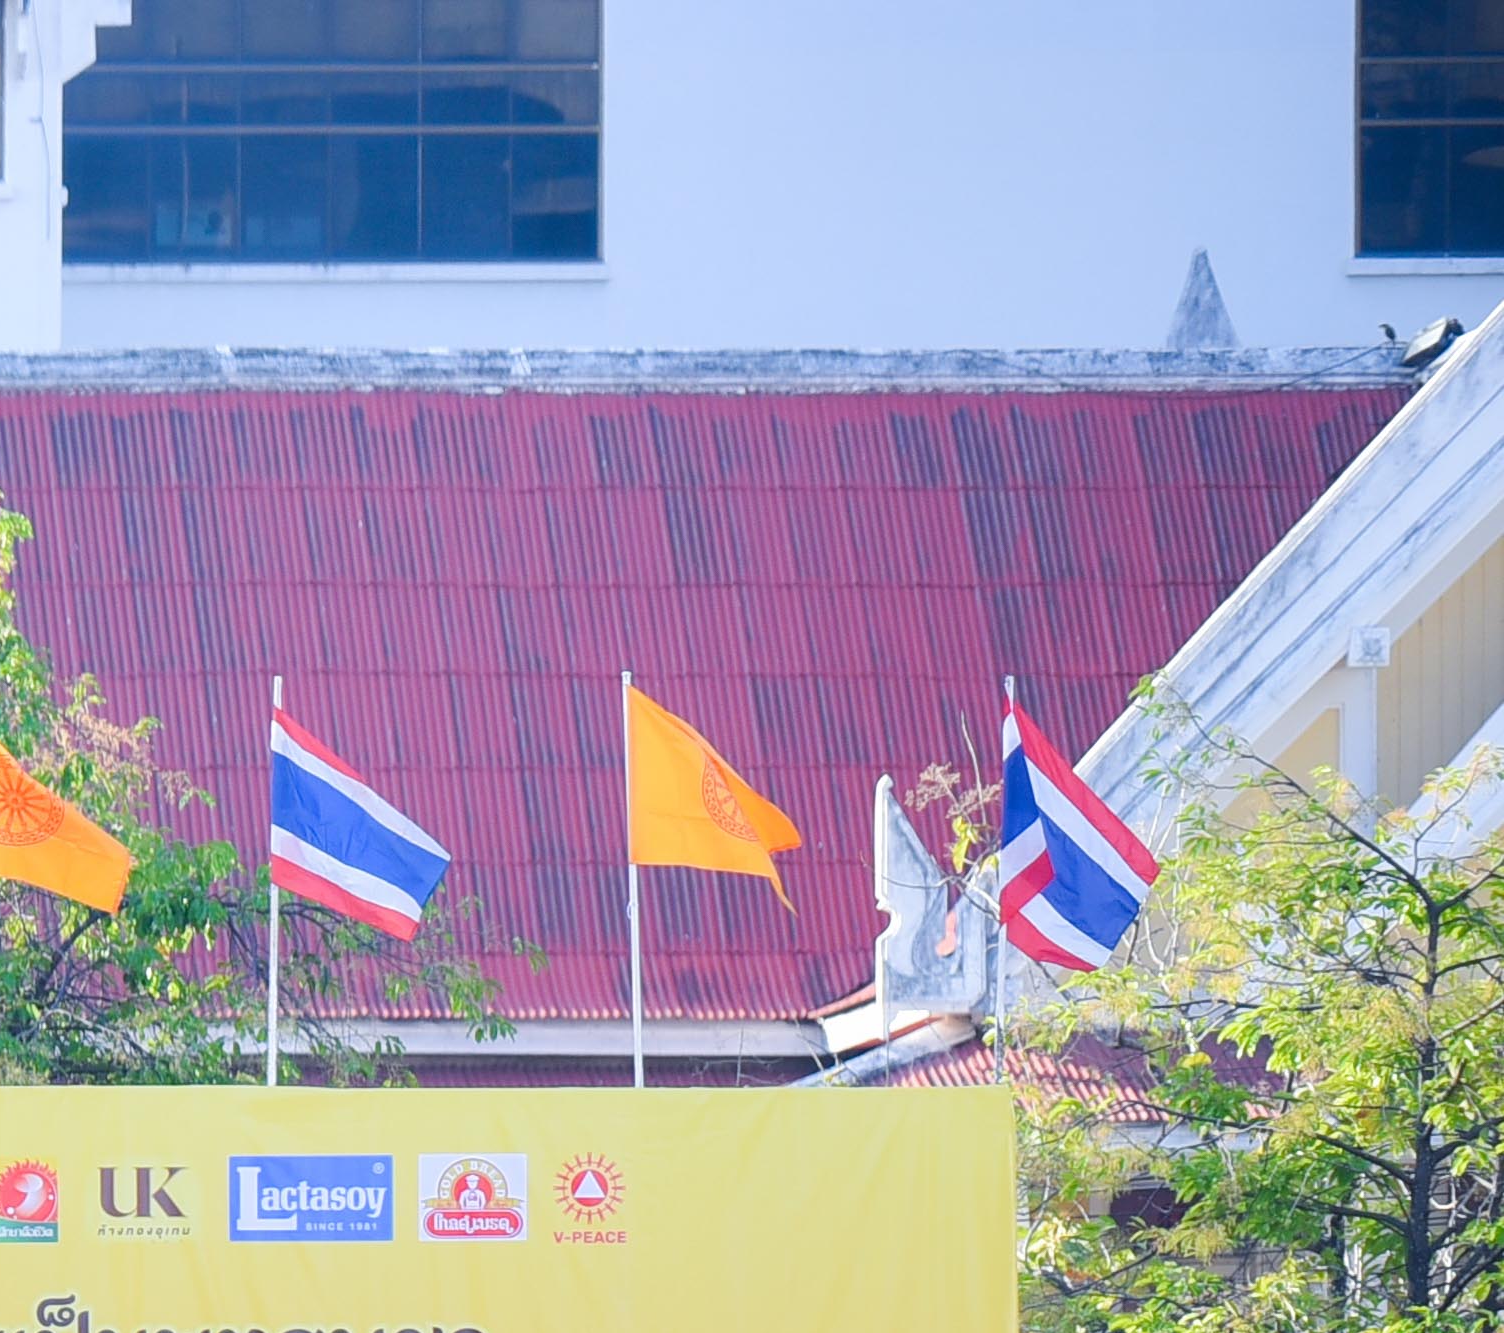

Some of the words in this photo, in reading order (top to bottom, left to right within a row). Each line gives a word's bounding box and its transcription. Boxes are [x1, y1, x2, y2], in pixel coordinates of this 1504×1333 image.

[97, 1166, 190, 1218] UK
[236, 1165, 387, 1231] Lactasoy
[305, 1222, 343, 1232] SINCE
[349, 1222, 378, 1232] 1981
[553, 1231, 627, 1244] V-PEACE
